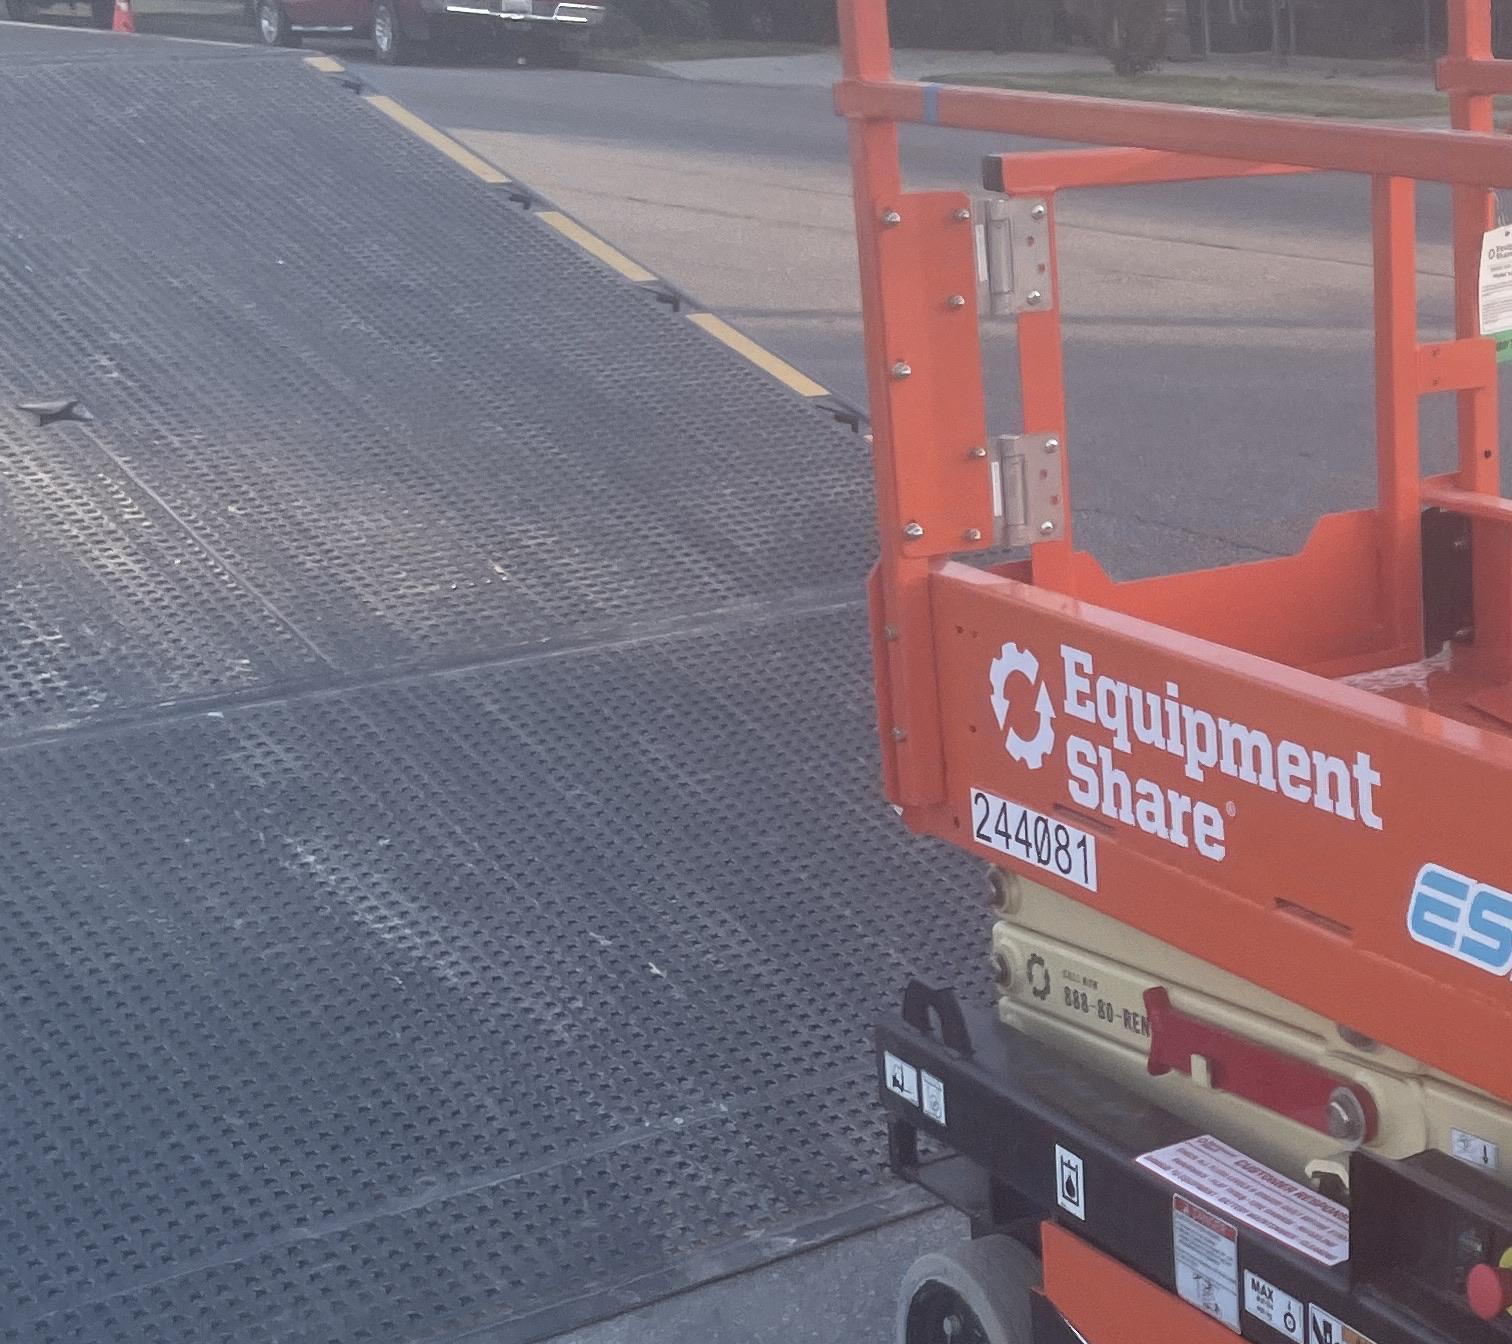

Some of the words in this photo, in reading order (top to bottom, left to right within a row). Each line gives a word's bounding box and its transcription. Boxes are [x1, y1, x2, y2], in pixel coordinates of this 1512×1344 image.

[1059, 643, 1384, 831] Equipment
[973, 792, 1091, 886] 244081
[1065, 735, 1227, 862] Share
[1251, 1277, 1274, 1303] MAX
